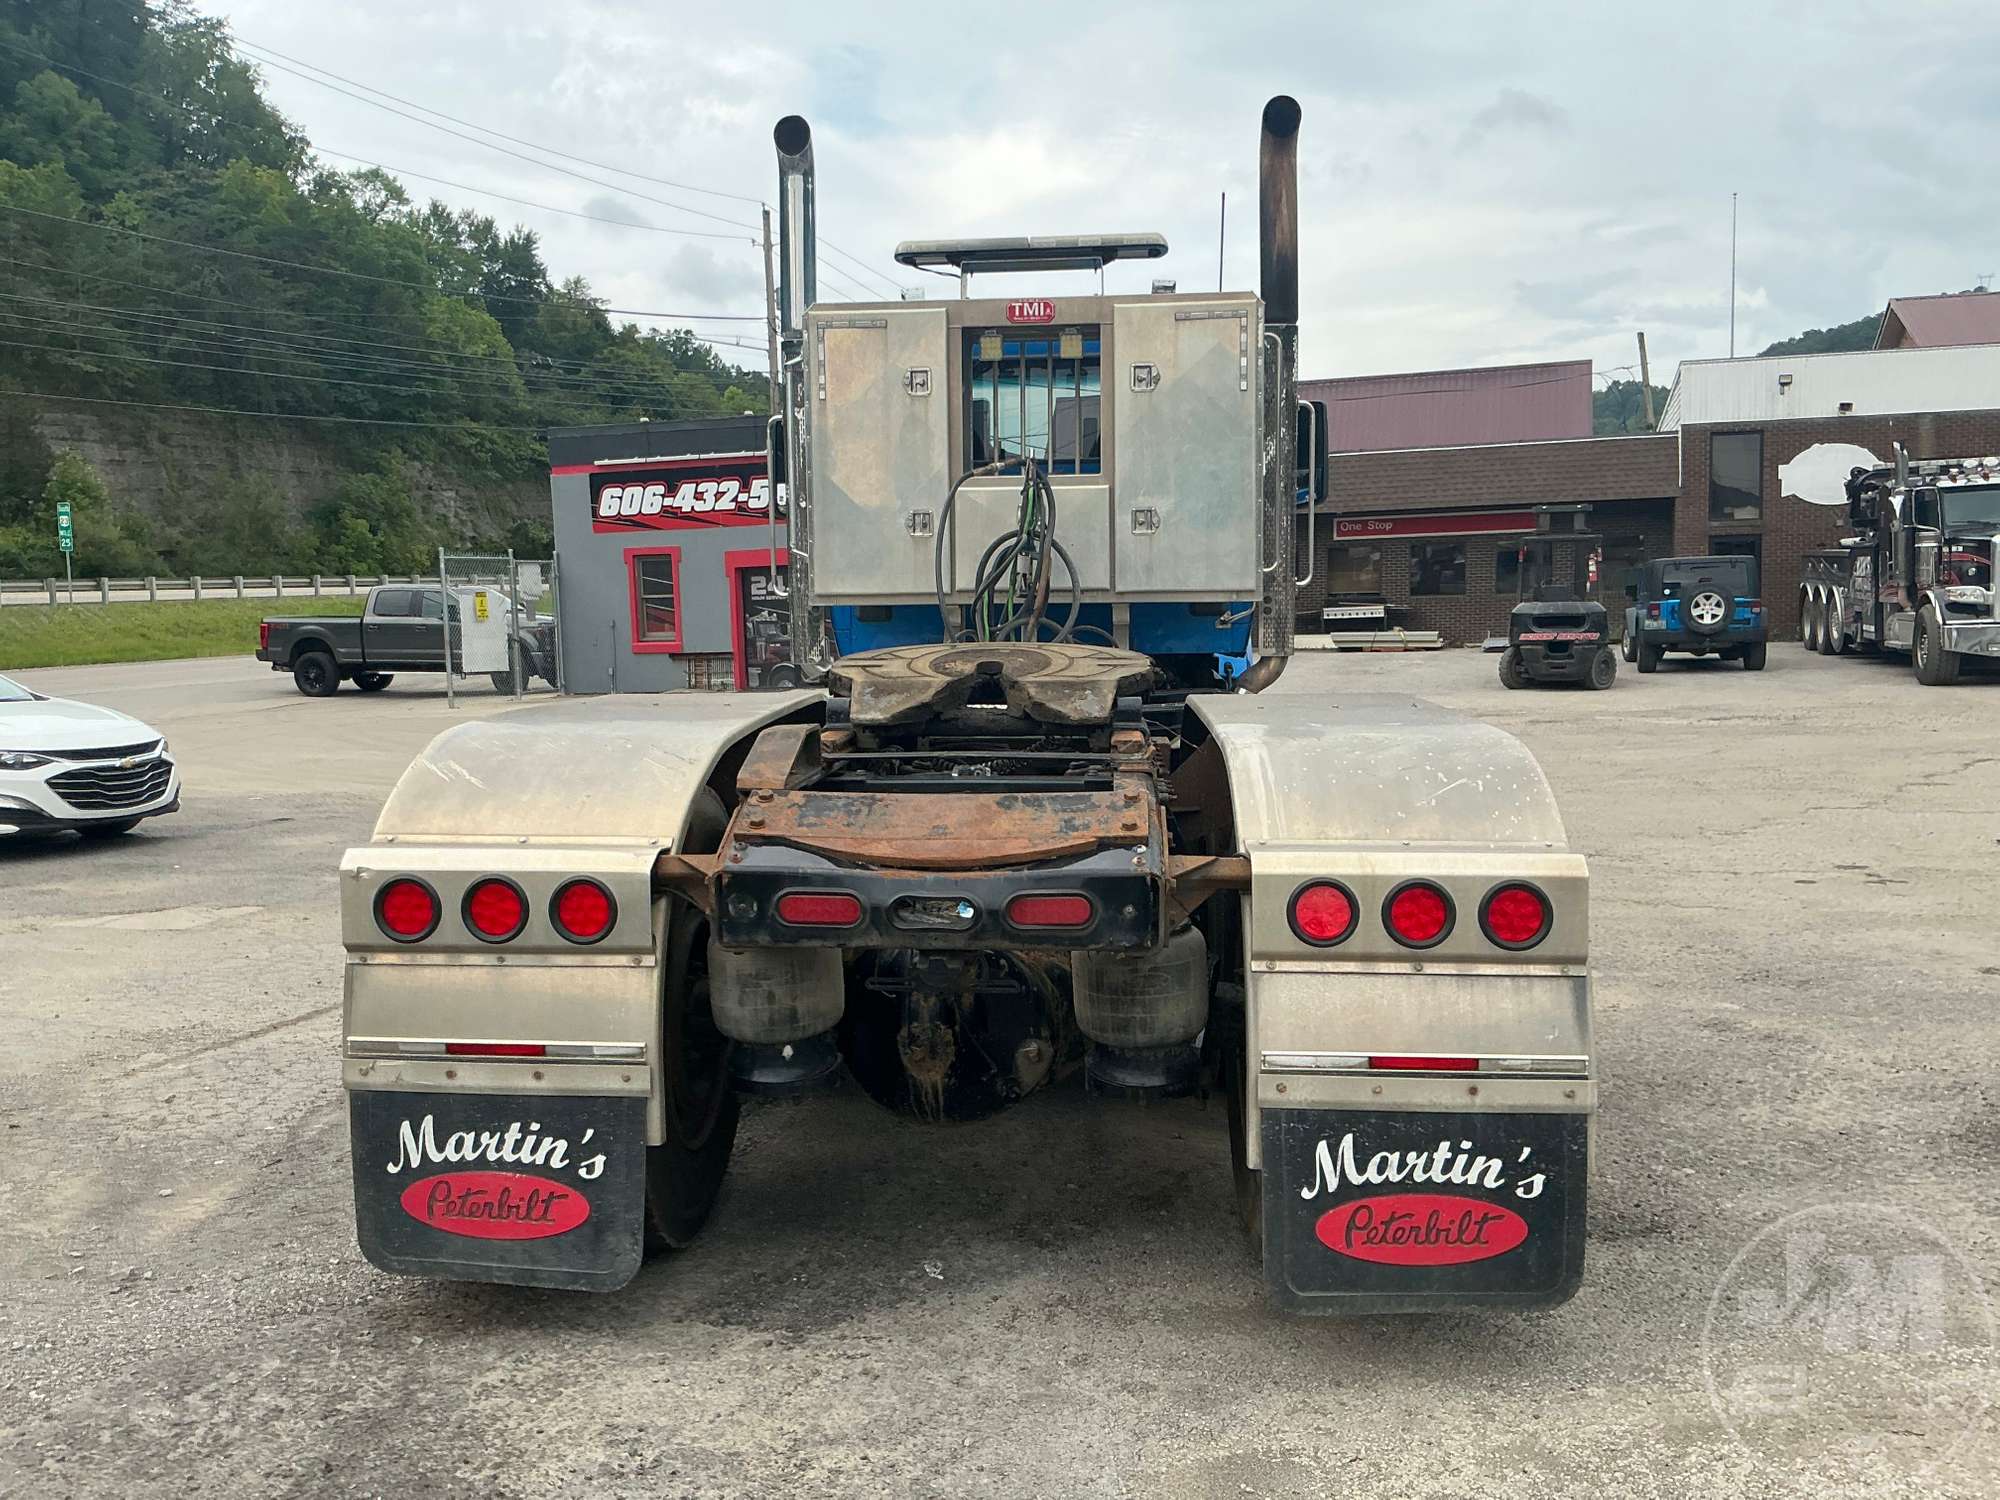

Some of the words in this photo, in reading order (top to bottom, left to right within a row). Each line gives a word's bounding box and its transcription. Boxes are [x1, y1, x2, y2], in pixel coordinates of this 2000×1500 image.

[1011, 302, 1044, 316] TMI
[1340, 521, 1362, 532] One
[1367, 520, 1393, 531] Stop
[386, 1114, 608, 1180] Martin's
[1300, 1132, 1547, 1200] Martin's
[426, 1180, 569, 1224] Peterbilt
[1343, 1204, 1507, 1249] Peterbilt
